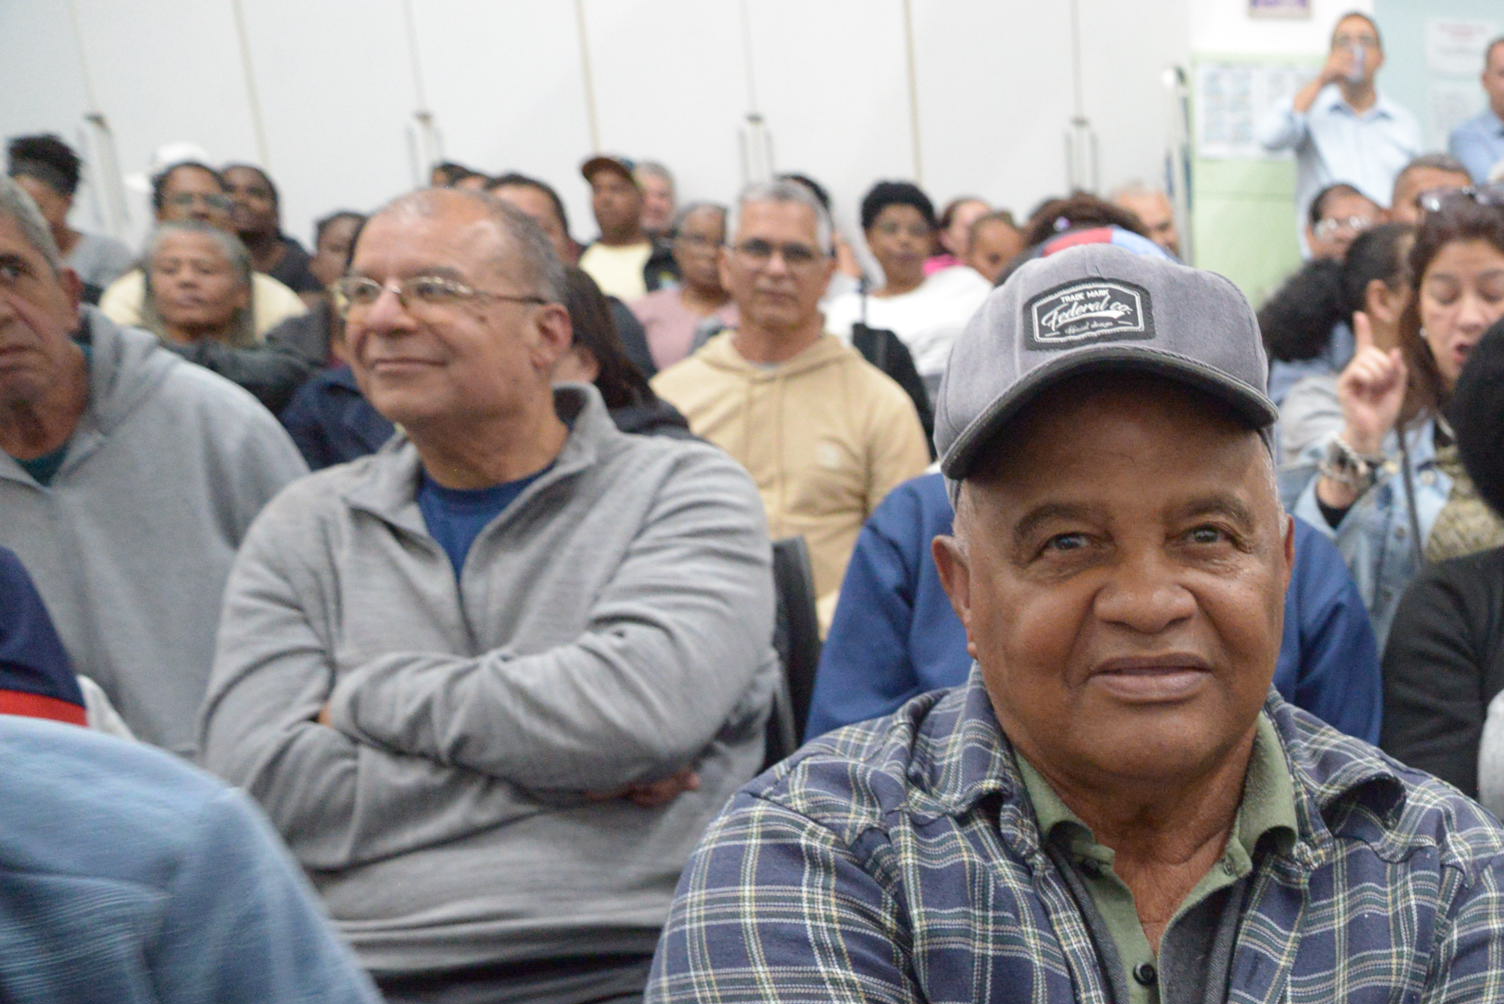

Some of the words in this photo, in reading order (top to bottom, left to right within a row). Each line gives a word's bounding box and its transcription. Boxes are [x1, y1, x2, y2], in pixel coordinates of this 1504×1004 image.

[1061, 292, 1085, 303] TRADE
[1085, 289, 1110, 299] MARK
[1041, 295, 1111, 331] Federal
